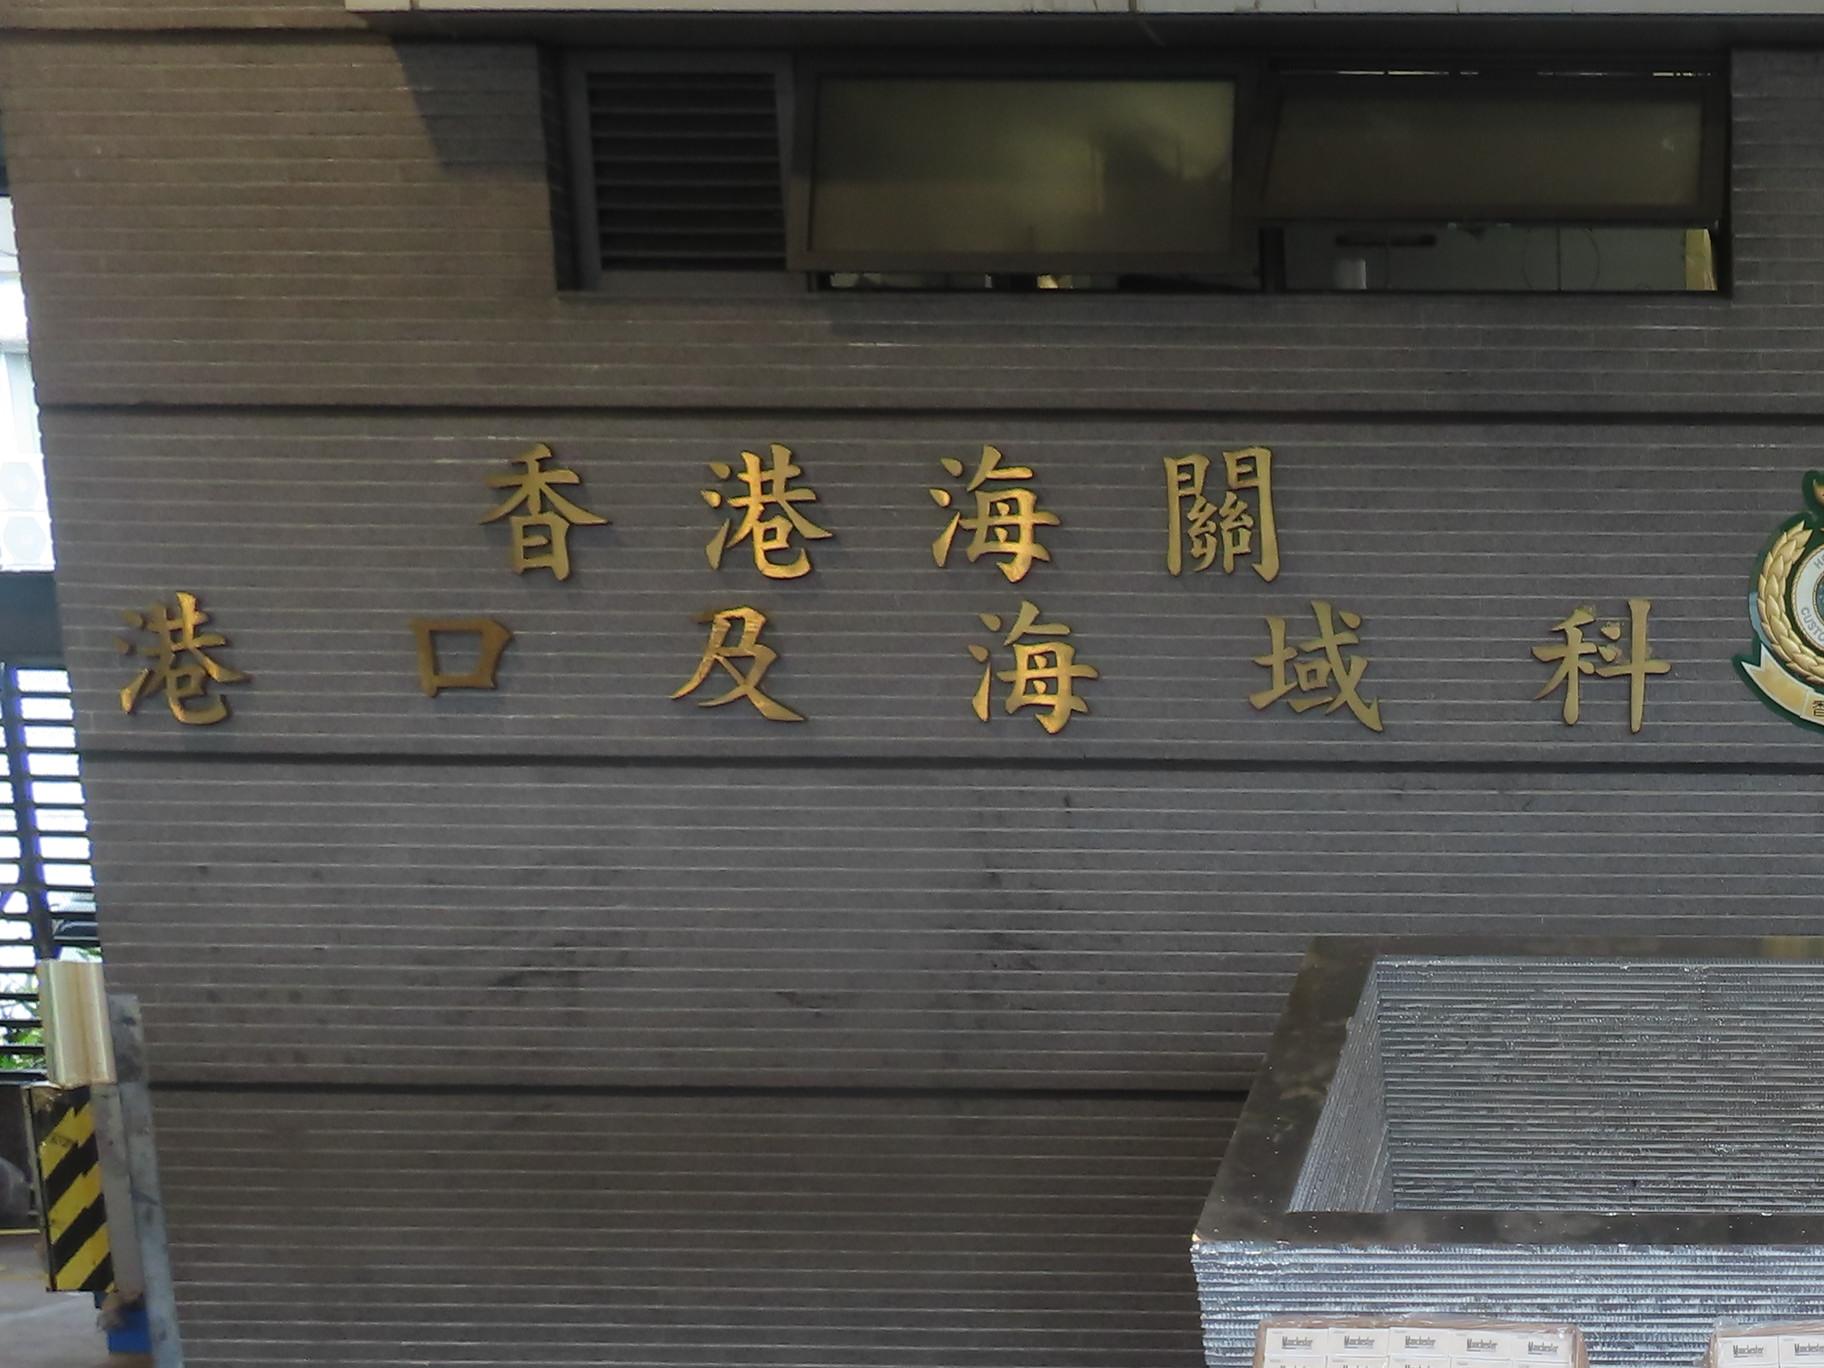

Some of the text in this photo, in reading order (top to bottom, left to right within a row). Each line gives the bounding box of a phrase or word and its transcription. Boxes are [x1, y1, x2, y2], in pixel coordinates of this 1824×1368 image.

[479, 443, 1282, 583] 香港海關
[115, 592, 1671, 734] 港口及海域科
